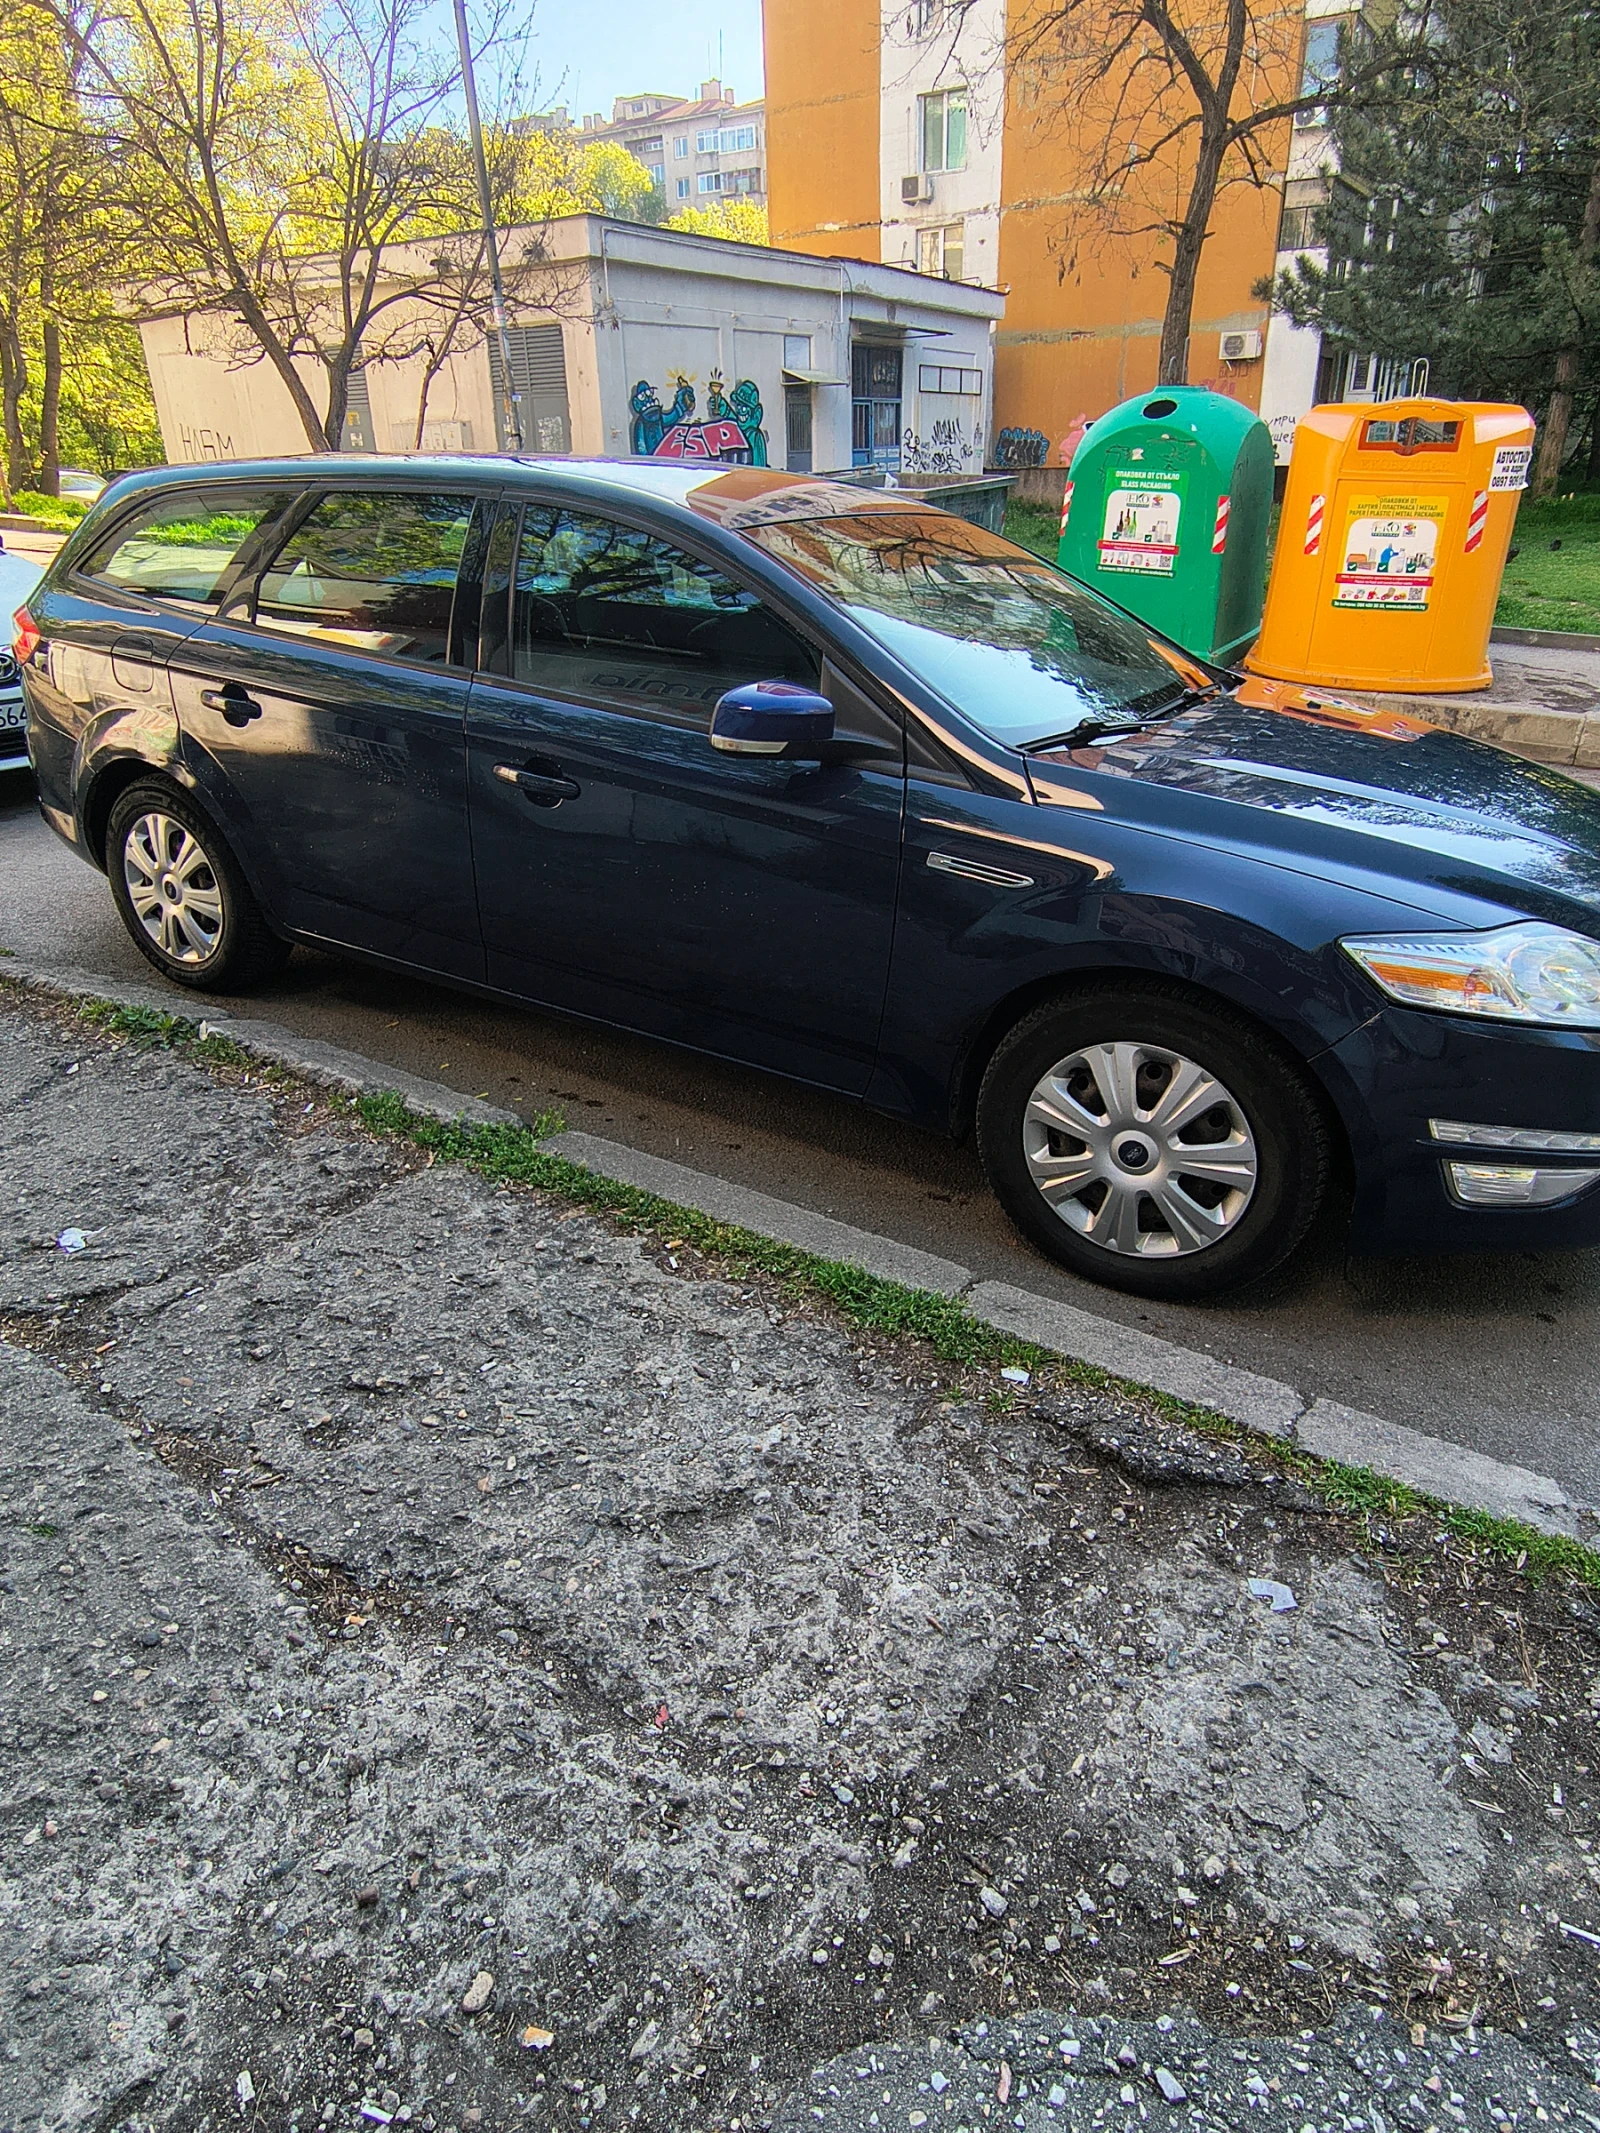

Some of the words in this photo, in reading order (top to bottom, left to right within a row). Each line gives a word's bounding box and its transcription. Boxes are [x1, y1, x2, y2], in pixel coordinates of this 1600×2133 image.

[1115, 470, 1146, 479] ОПАКОВКИ
[1147, 471, 1155, 479] ОТ
[1121, 480, 1139, 488] GLASS
[1140, 481, 1172, 490] PACKAGING
